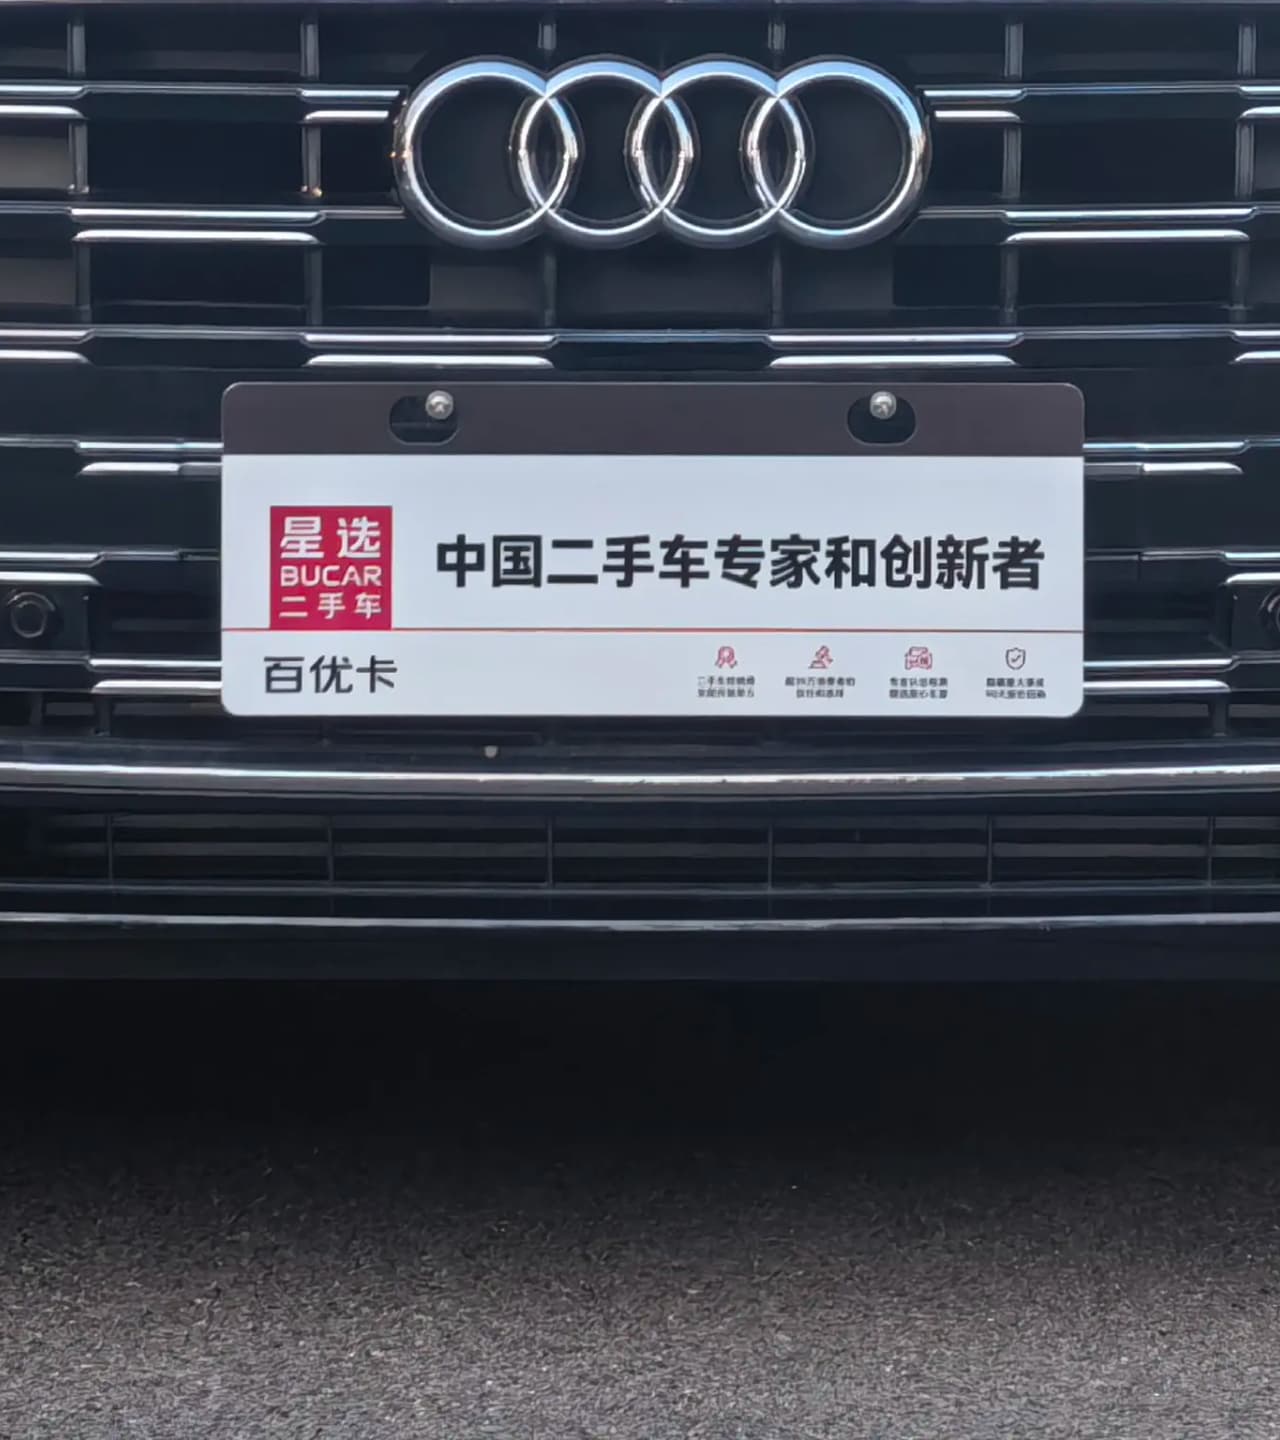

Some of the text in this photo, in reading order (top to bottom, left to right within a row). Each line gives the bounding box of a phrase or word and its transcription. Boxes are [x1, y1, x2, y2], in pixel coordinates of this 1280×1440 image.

[280, 516, 381, 559] 星选
[280, 564, 382, 588] BUCAR
[436, 533, 1045, 590] 中国二手车专家和创新者
[279, 592, 382, 620] 二手车
[263, 654, 398, 694] 百优卡
